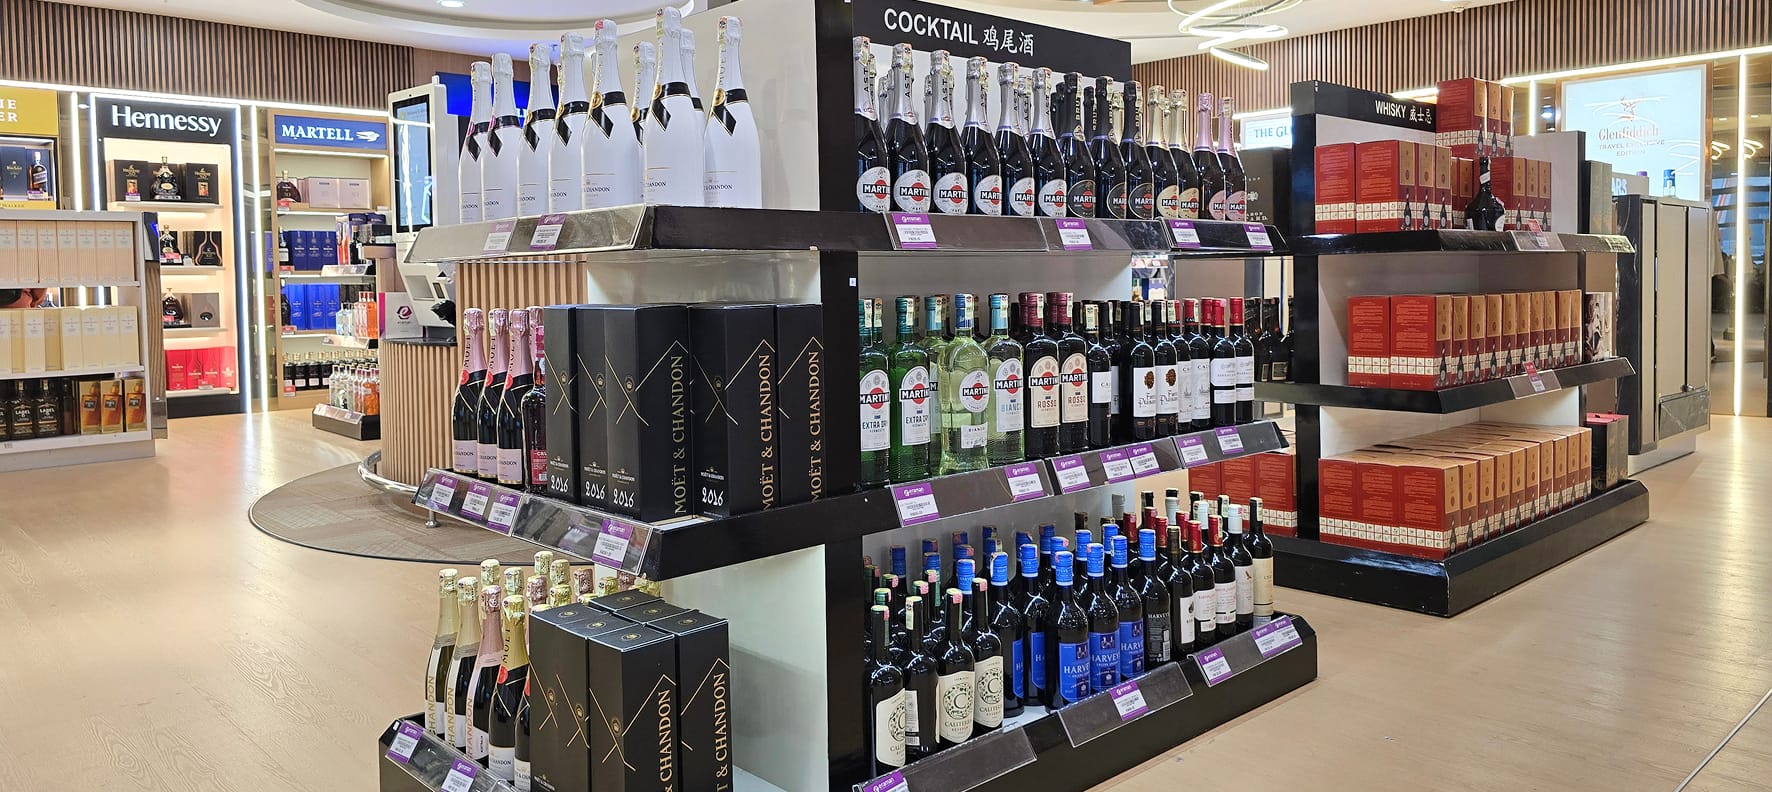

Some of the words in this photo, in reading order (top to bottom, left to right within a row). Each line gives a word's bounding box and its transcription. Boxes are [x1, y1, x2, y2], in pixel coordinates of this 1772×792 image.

[884, 8, 979, 45] COCKTAIL
[982, 25, 1035, 57] 鸡尾酒
[1375, 100, 1406, 118] WHISKY
[112, 104, 222, 137] Hennessy
[282, 124, 354, 141] MARTELL
[1255, 127, 1273, 138] THE
[1599, 126, 1659, 141] Glenfiddich
[671, 355, 685, 443] CHANDON
[759, 354, 773, 442] CHANDON
[808, 351, 822, 435] CHANDON
[862, 421, 880, 430] EXTRA
[905, 416, 922, 424] EXTRA
[673, 448, 686, 459] &
[761, 446, 773, 458] &
[810, 440, 822, 451] &
[550, 475, 569, 493] 2016
[585, 480, 606, 500] 2016
[671, 465, 687, 514] MOËT
[613, 488, 635, 508] 2016
[702, 487, 724, 507] 2016
[713, 673, 728, 762] CHANDON
[658, 690, 673, 782] CHANDON
[716, 764, 728, 778] &
